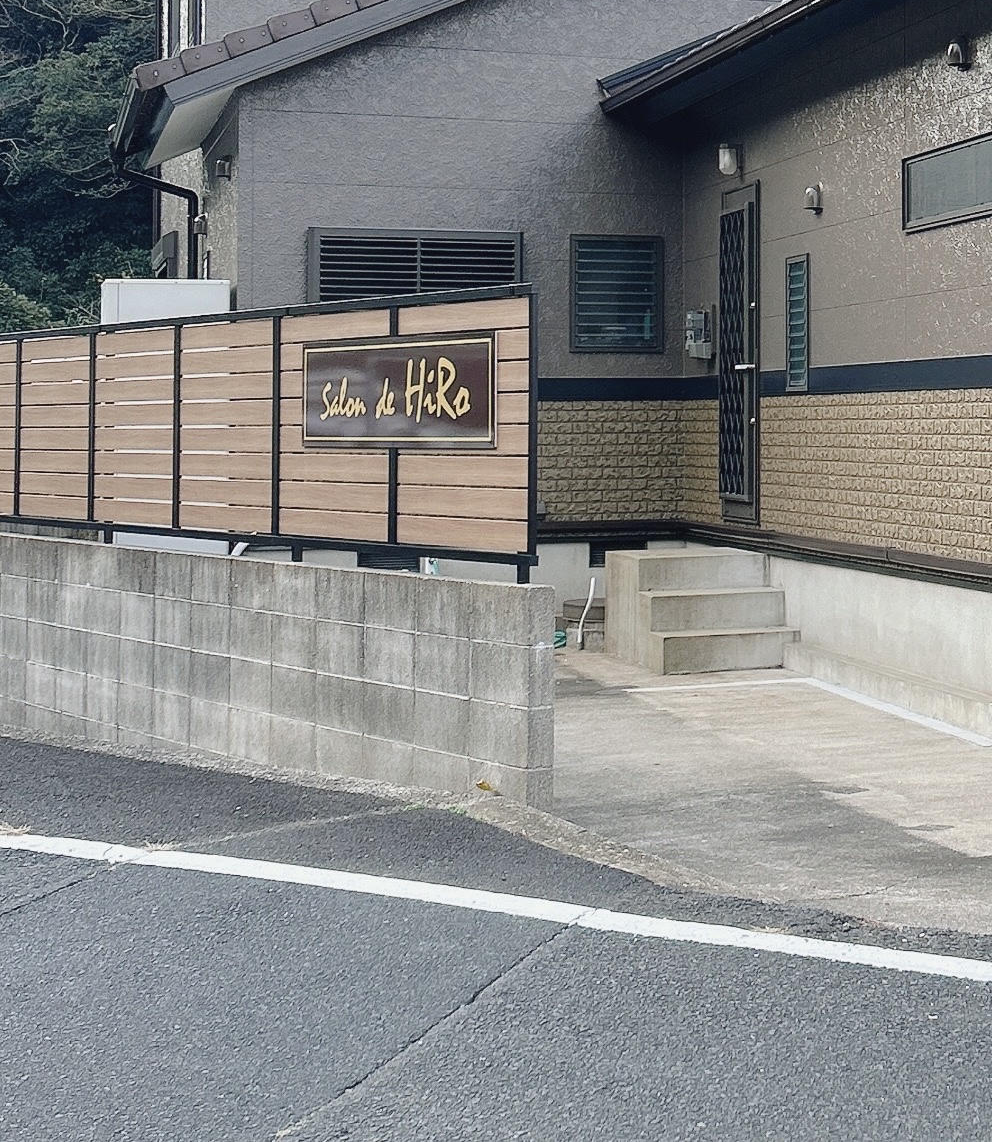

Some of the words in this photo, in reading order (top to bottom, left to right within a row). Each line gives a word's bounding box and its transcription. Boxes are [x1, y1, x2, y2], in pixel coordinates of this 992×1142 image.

[320, 376, 367, 421] Salon
[375, 377, 396, 419] de
[404, 356, 472, 423] HiRo
